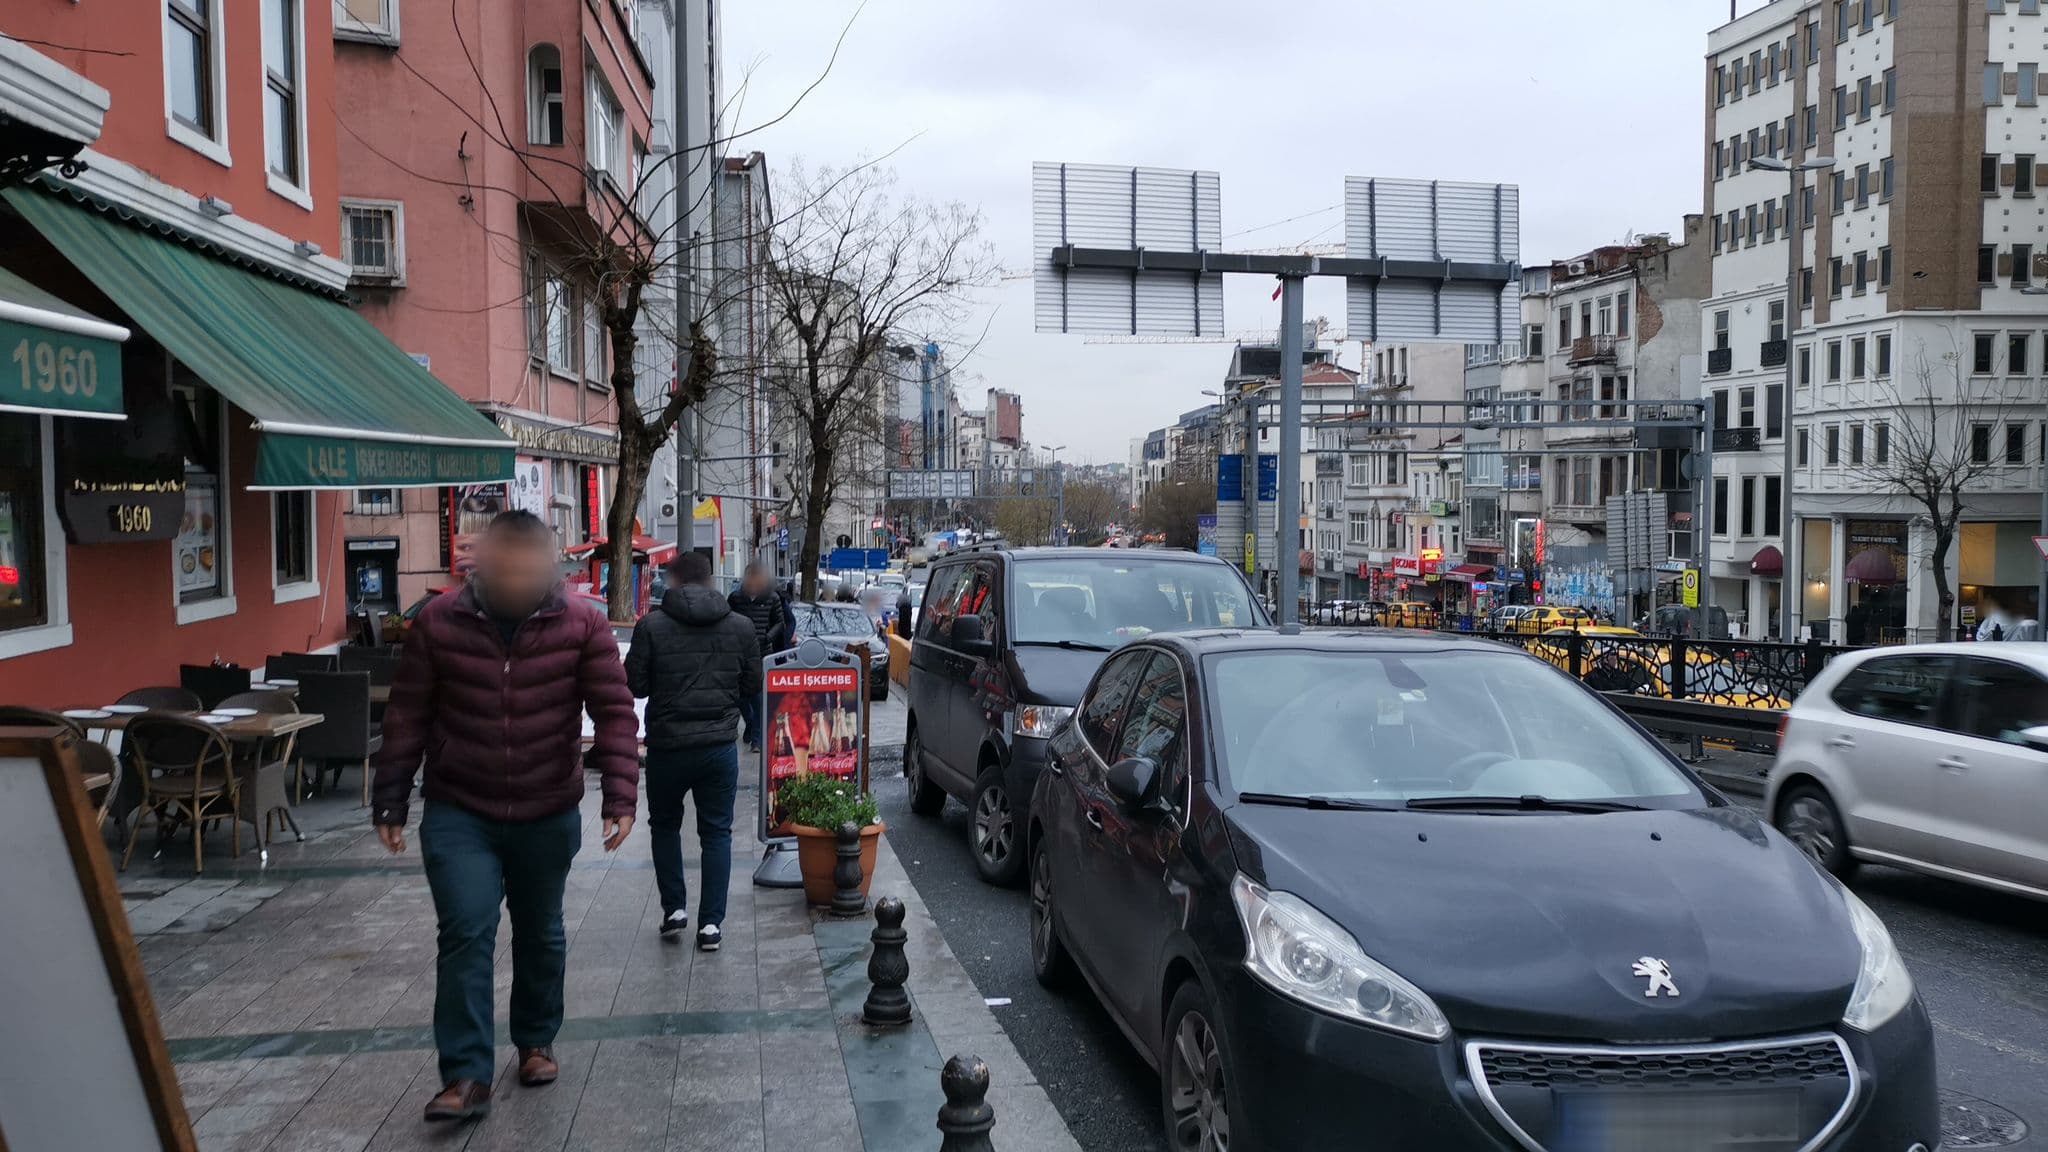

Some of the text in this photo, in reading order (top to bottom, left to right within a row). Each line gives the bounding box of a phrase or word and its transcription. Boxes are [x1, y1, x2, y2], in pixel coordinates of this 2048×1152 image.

[13, 338, 97, 397] 1960
[307, 447, 349, 478] LALE
[117, 504, 151, 532] 1960
[772, 673, 852, 688] LALE İŞKEMBE
